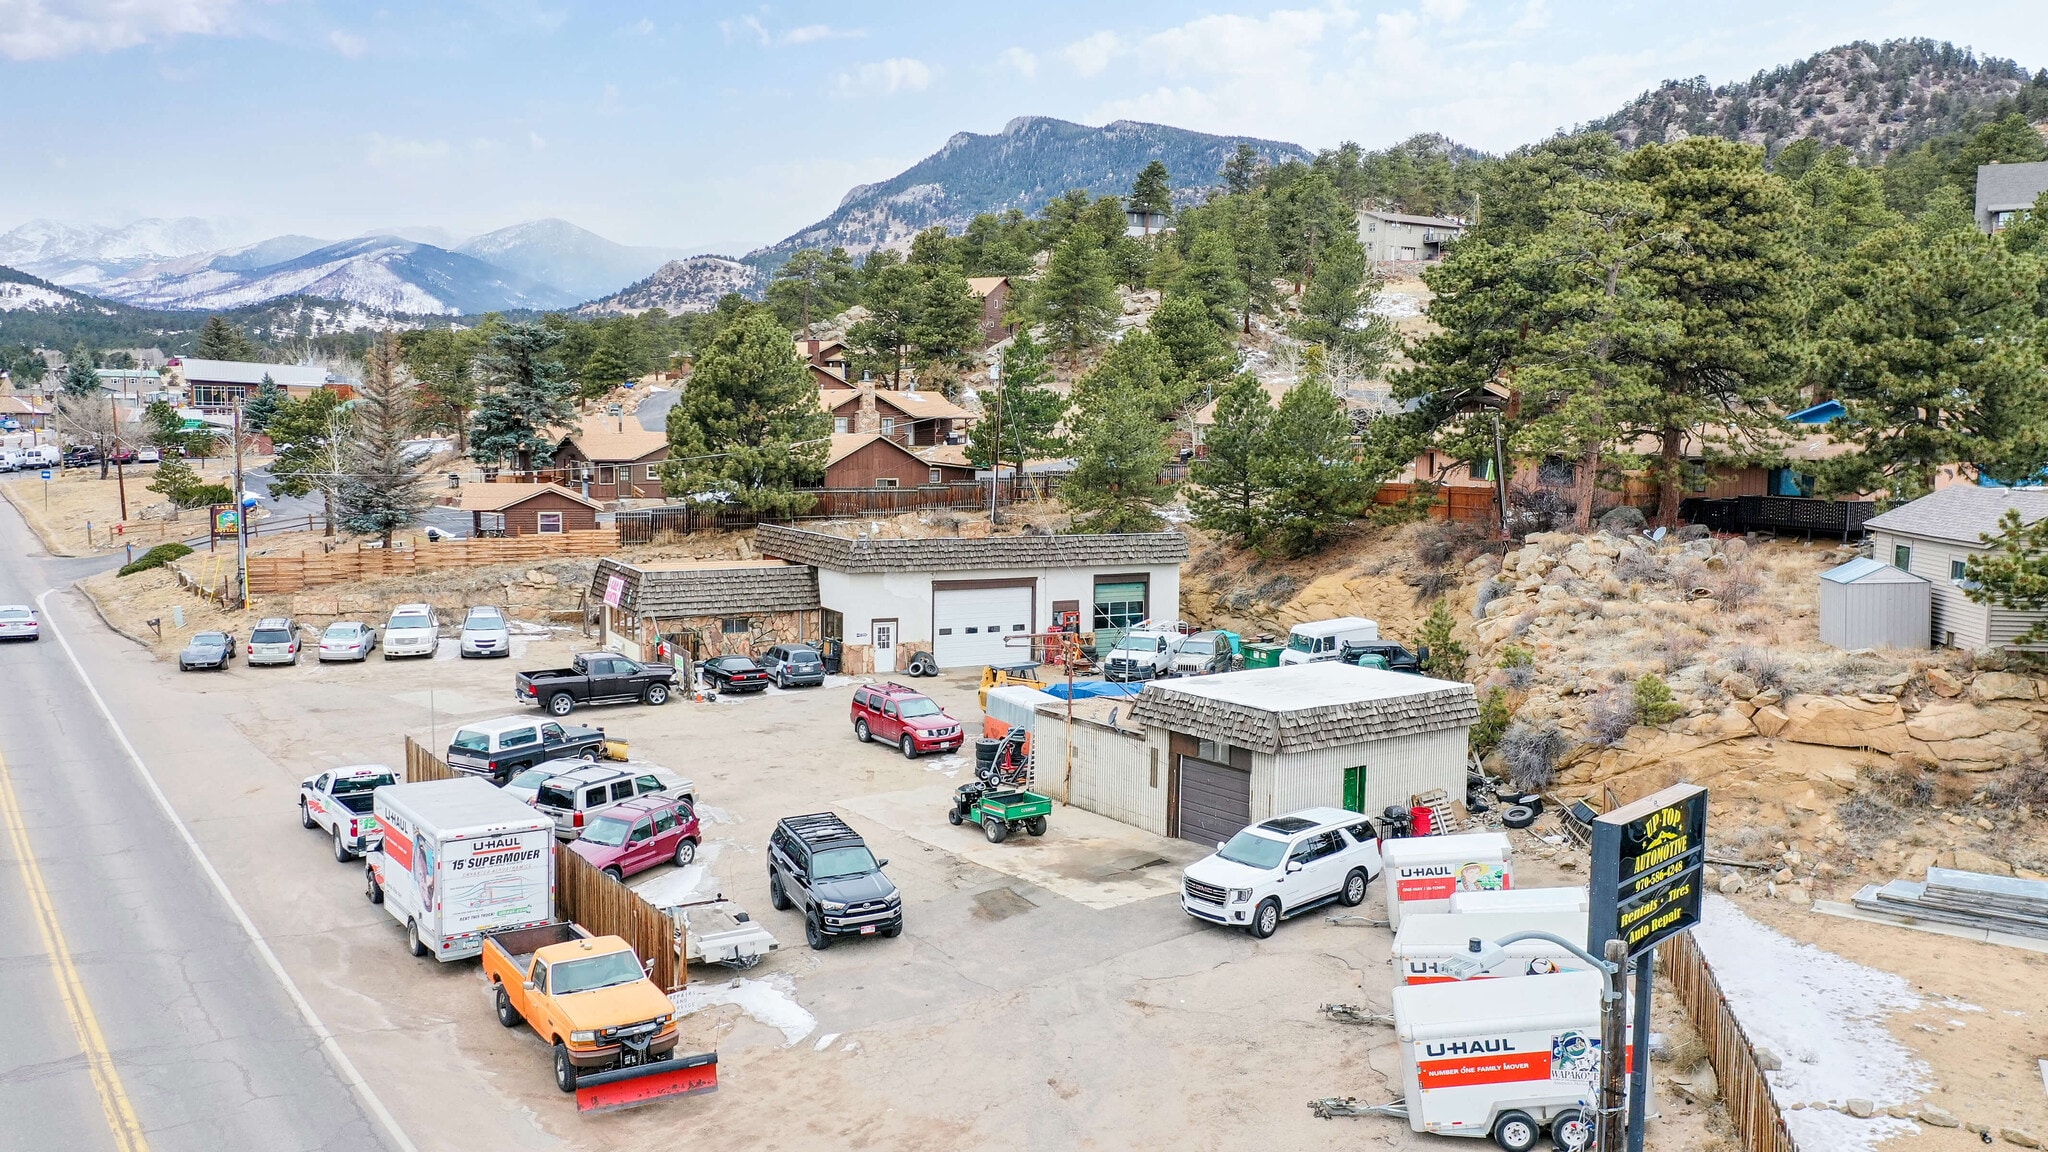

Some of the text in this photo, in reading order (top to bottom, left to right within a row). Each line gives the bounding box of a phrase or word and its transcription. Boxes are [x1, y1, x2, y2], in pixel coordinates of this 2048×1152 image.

[385, 807, 408, 834] U-HAUL
[473, 837, 521, 851] U-HAUL
[1634, 835, 1688, 875] AUTOMOTIVE
[467, 849, 540, 869] SUPERMOVER
[1401, 866, 1452, 878] U-HAUL
[1635, 860, 1683, 893] 970-586-4248
[1620, 883, 1690, 929] Rentals Tires
[1628, 907, 1682, 945] Auto Repair
[1426, 1038, 1515, 1057] U-HAUL
[1428, 1068, 1459, 1077] NUMBER
[1477, 1065, 1502, 1073] FAMILY
